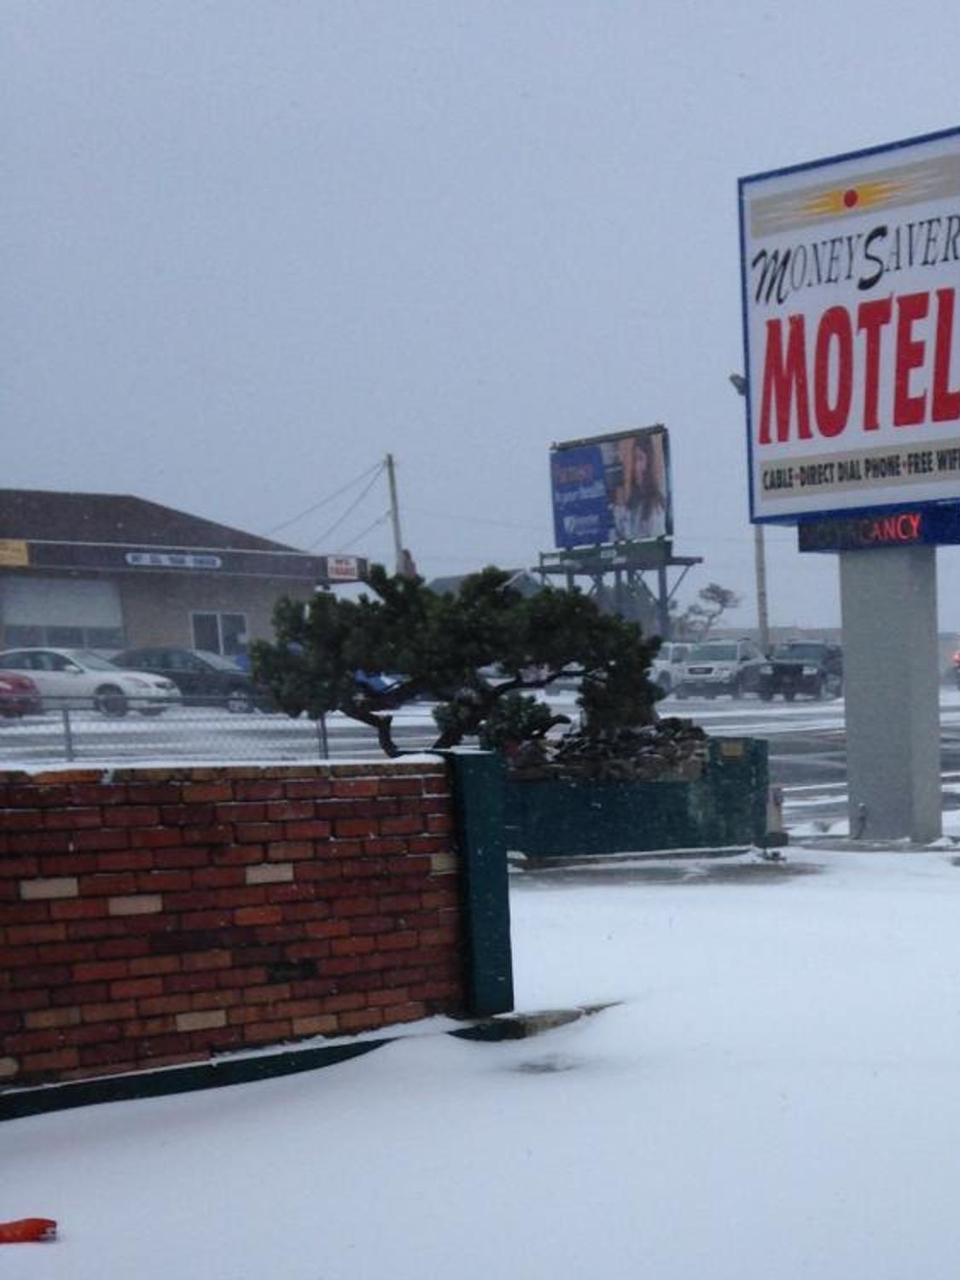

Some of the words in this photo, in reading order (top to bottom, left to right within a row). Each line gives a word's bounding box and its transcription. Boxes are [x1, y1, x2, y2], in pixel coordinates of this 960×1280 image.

[837, 459, 862, 482] DIAL
[864, 454, 900, 479] PHONE
[908, 450, 933, 475] FREE
